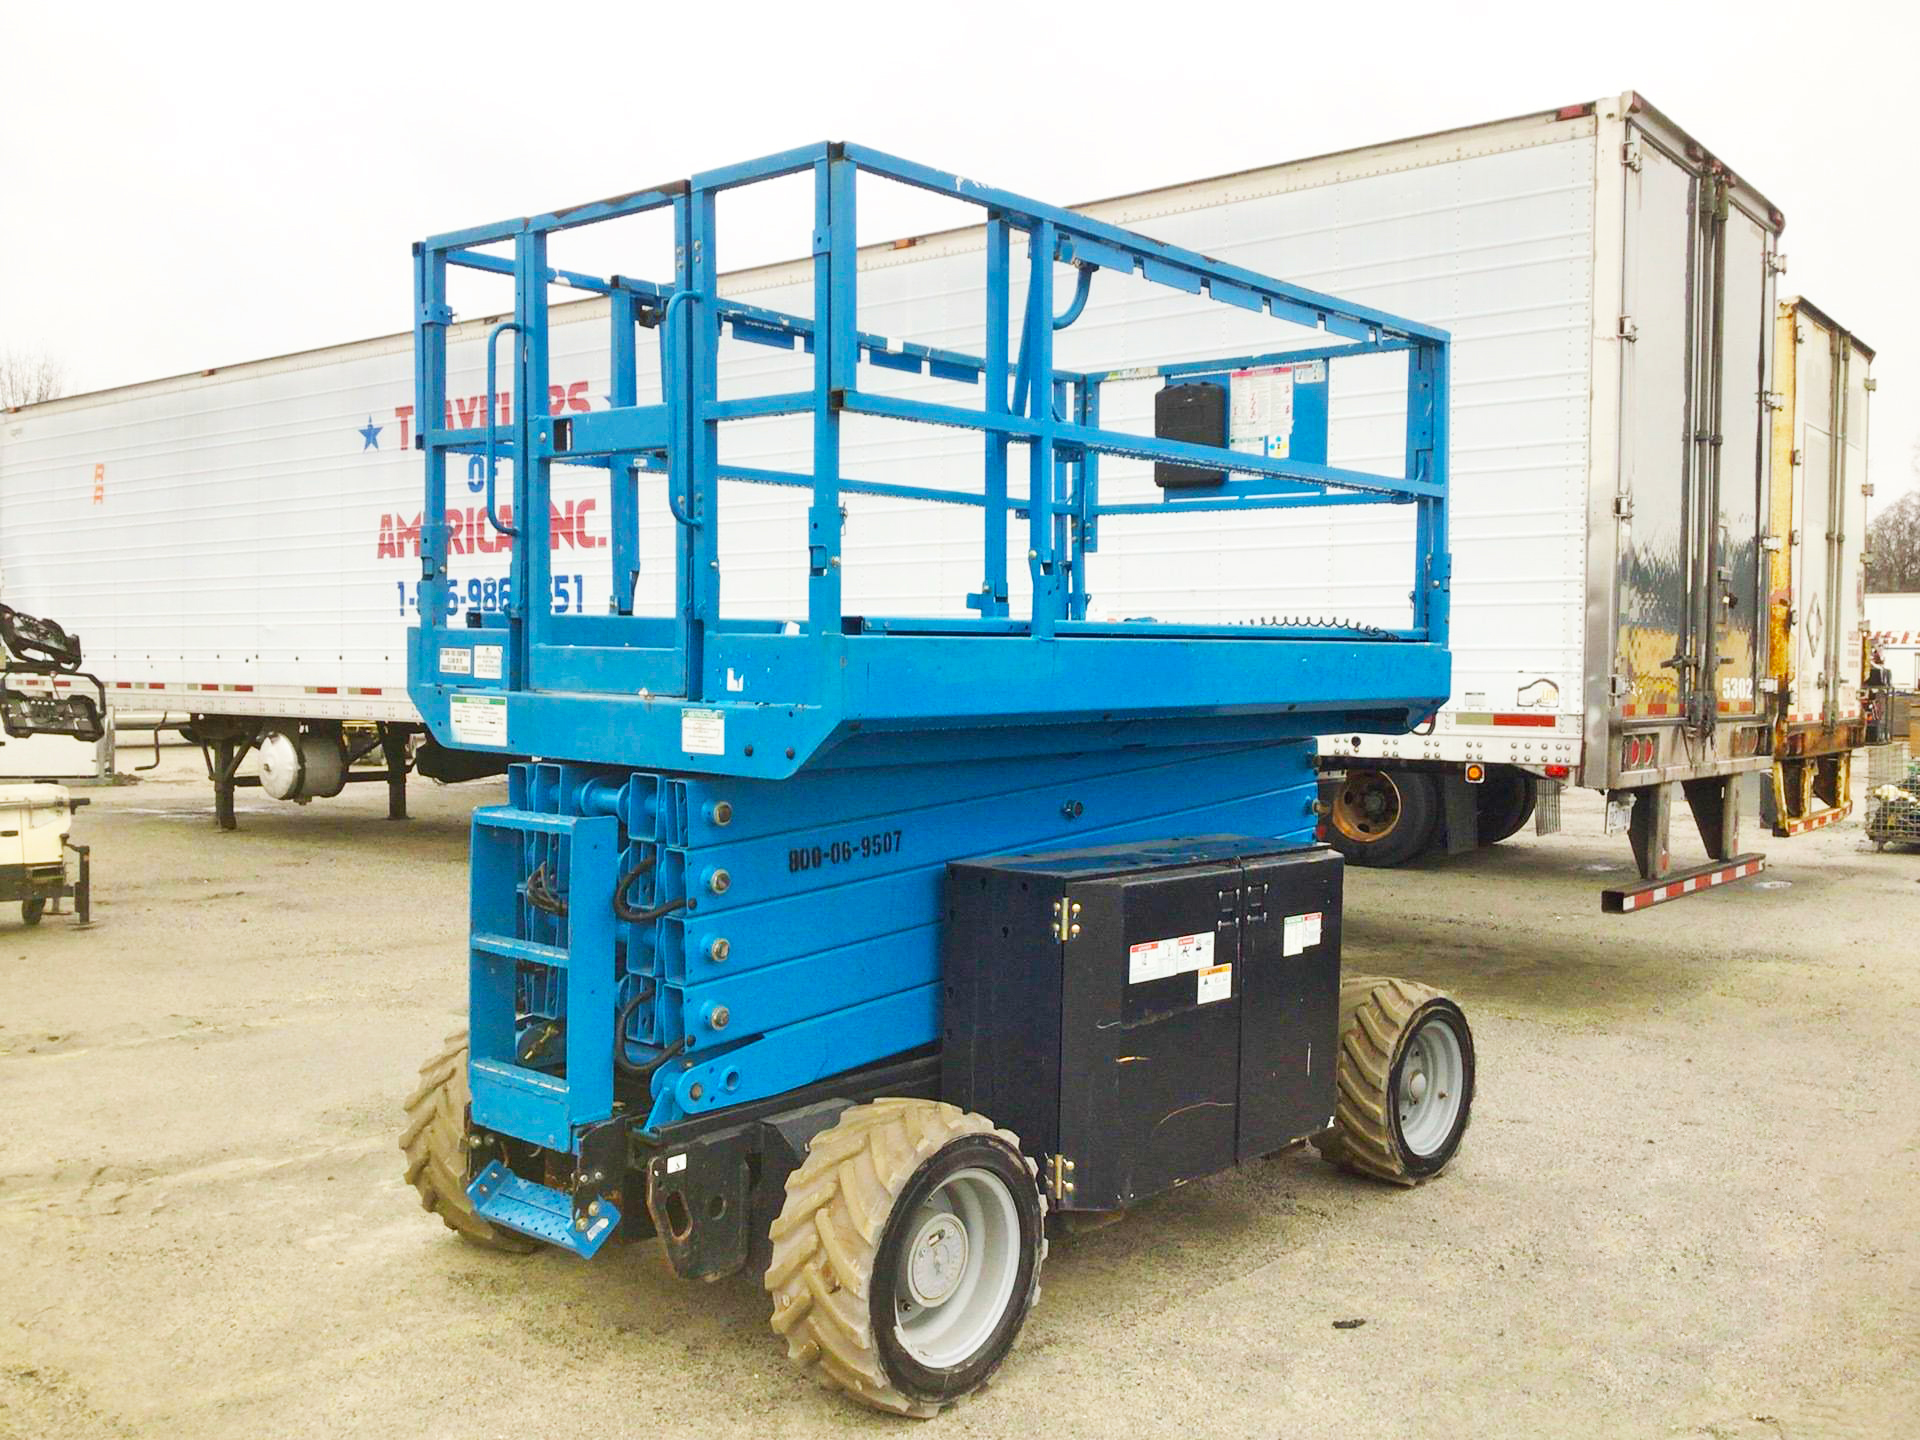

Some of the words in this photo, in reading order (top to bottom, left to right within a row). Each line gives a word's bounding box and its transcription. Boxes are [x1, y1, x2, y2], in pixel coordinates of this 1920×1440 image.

[377, 504, 514, 559] AMRICA
[543, 498, 607, 551] NC.
[1722, 677, 1753, 699] 5302
[789, 829, 902, 873] 800-06-9507
